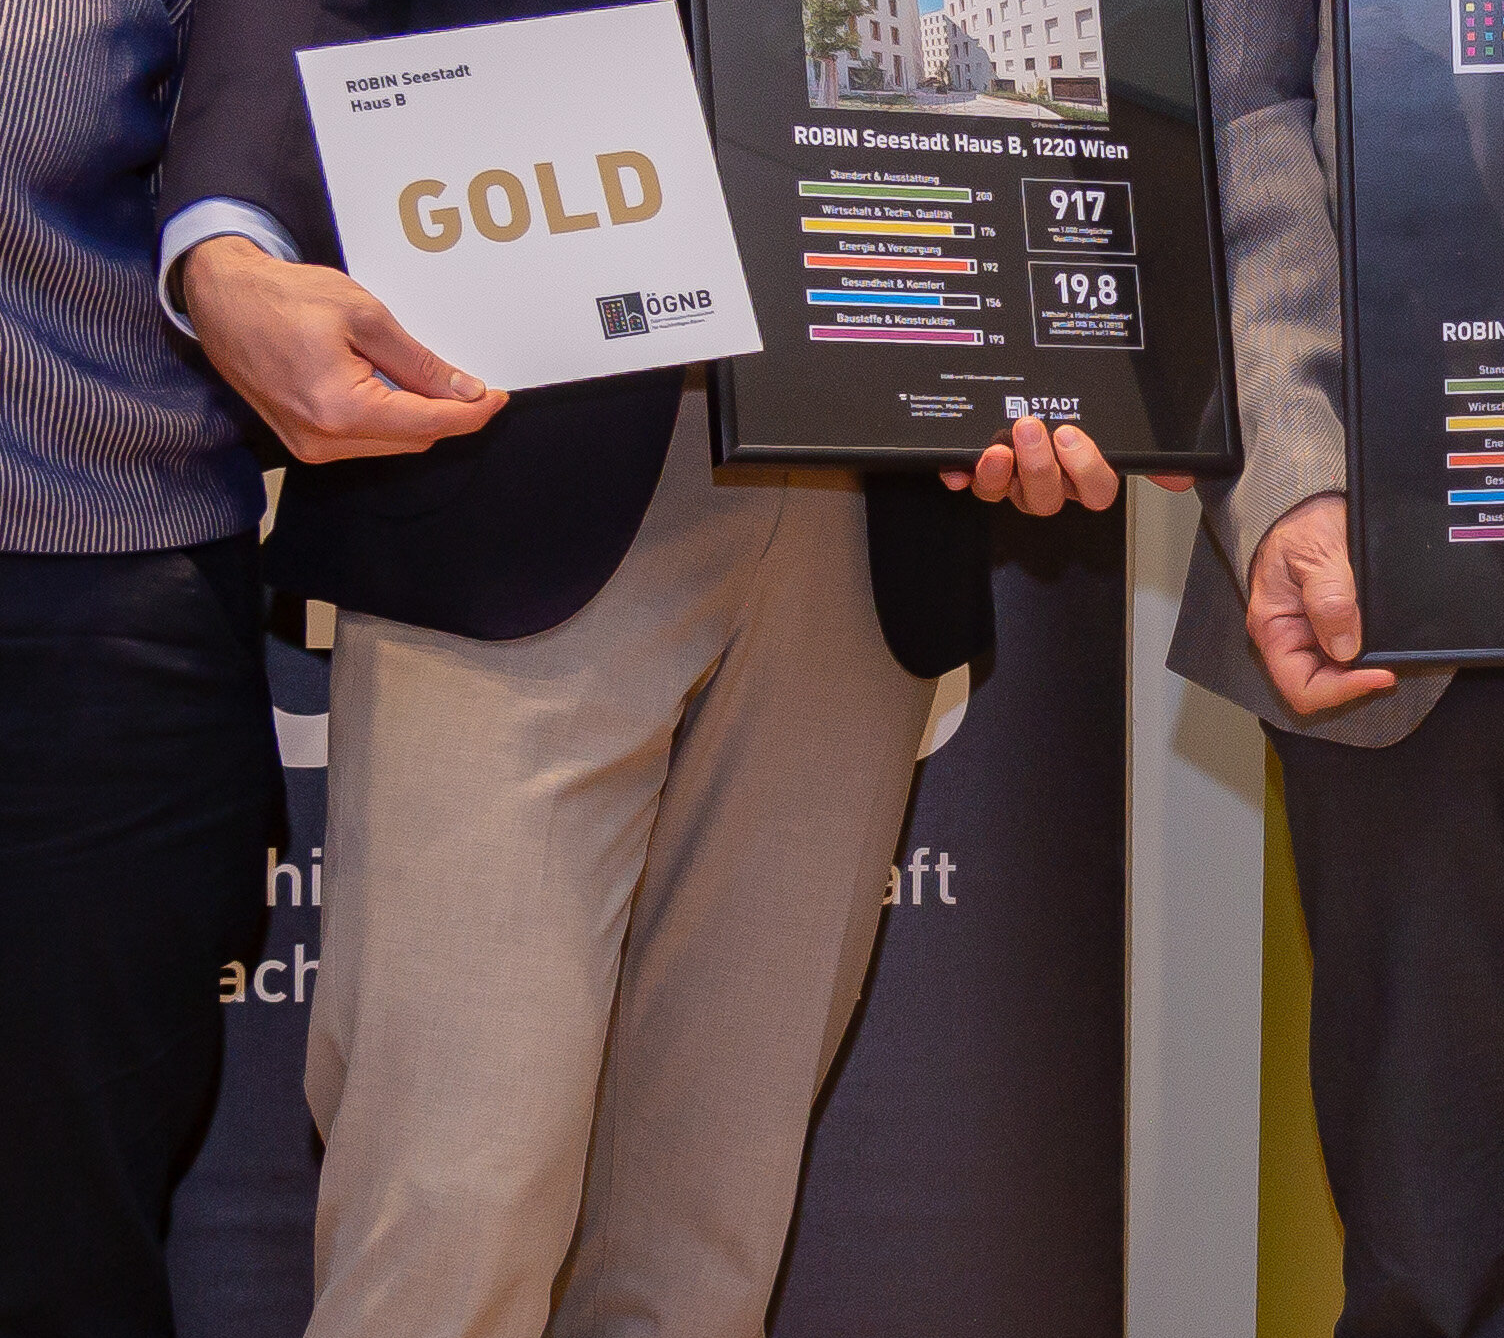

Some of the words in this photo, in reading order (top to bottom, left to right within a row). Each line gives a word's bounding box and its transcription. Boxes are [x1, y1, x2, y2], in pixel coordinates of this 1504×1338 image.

[345, 74, 398, 93] ROBIN
[401, 64, 472, 85] Seestadt
[350, 98, 392, 112] Haus
[394, 93, 407, 107] B
[793, 125, 858, 148] ROBIN
[863, 129, 949, 152] Seestadt
[955, 134, 1003, 154] Haus
[1007, 136, 1027, 157] B,
[1033, 137, 1076, 157] 1220
[1080, 139, 1129, 160] Wien
[830, 169, 871, 181] Standort
[398, 150, 663, 253] GOLD
[1050, 189, 1105, 222] 917
[981, 227, 996, 237] 176
[982, 262, 999, 272] 192
[646, 289, 712, 316] ÖGNB
[986, 298, 1001, 307] 156
[1054, 273, 1117, 311] 19,8
[1031, 397, 1080, 410] STADT
